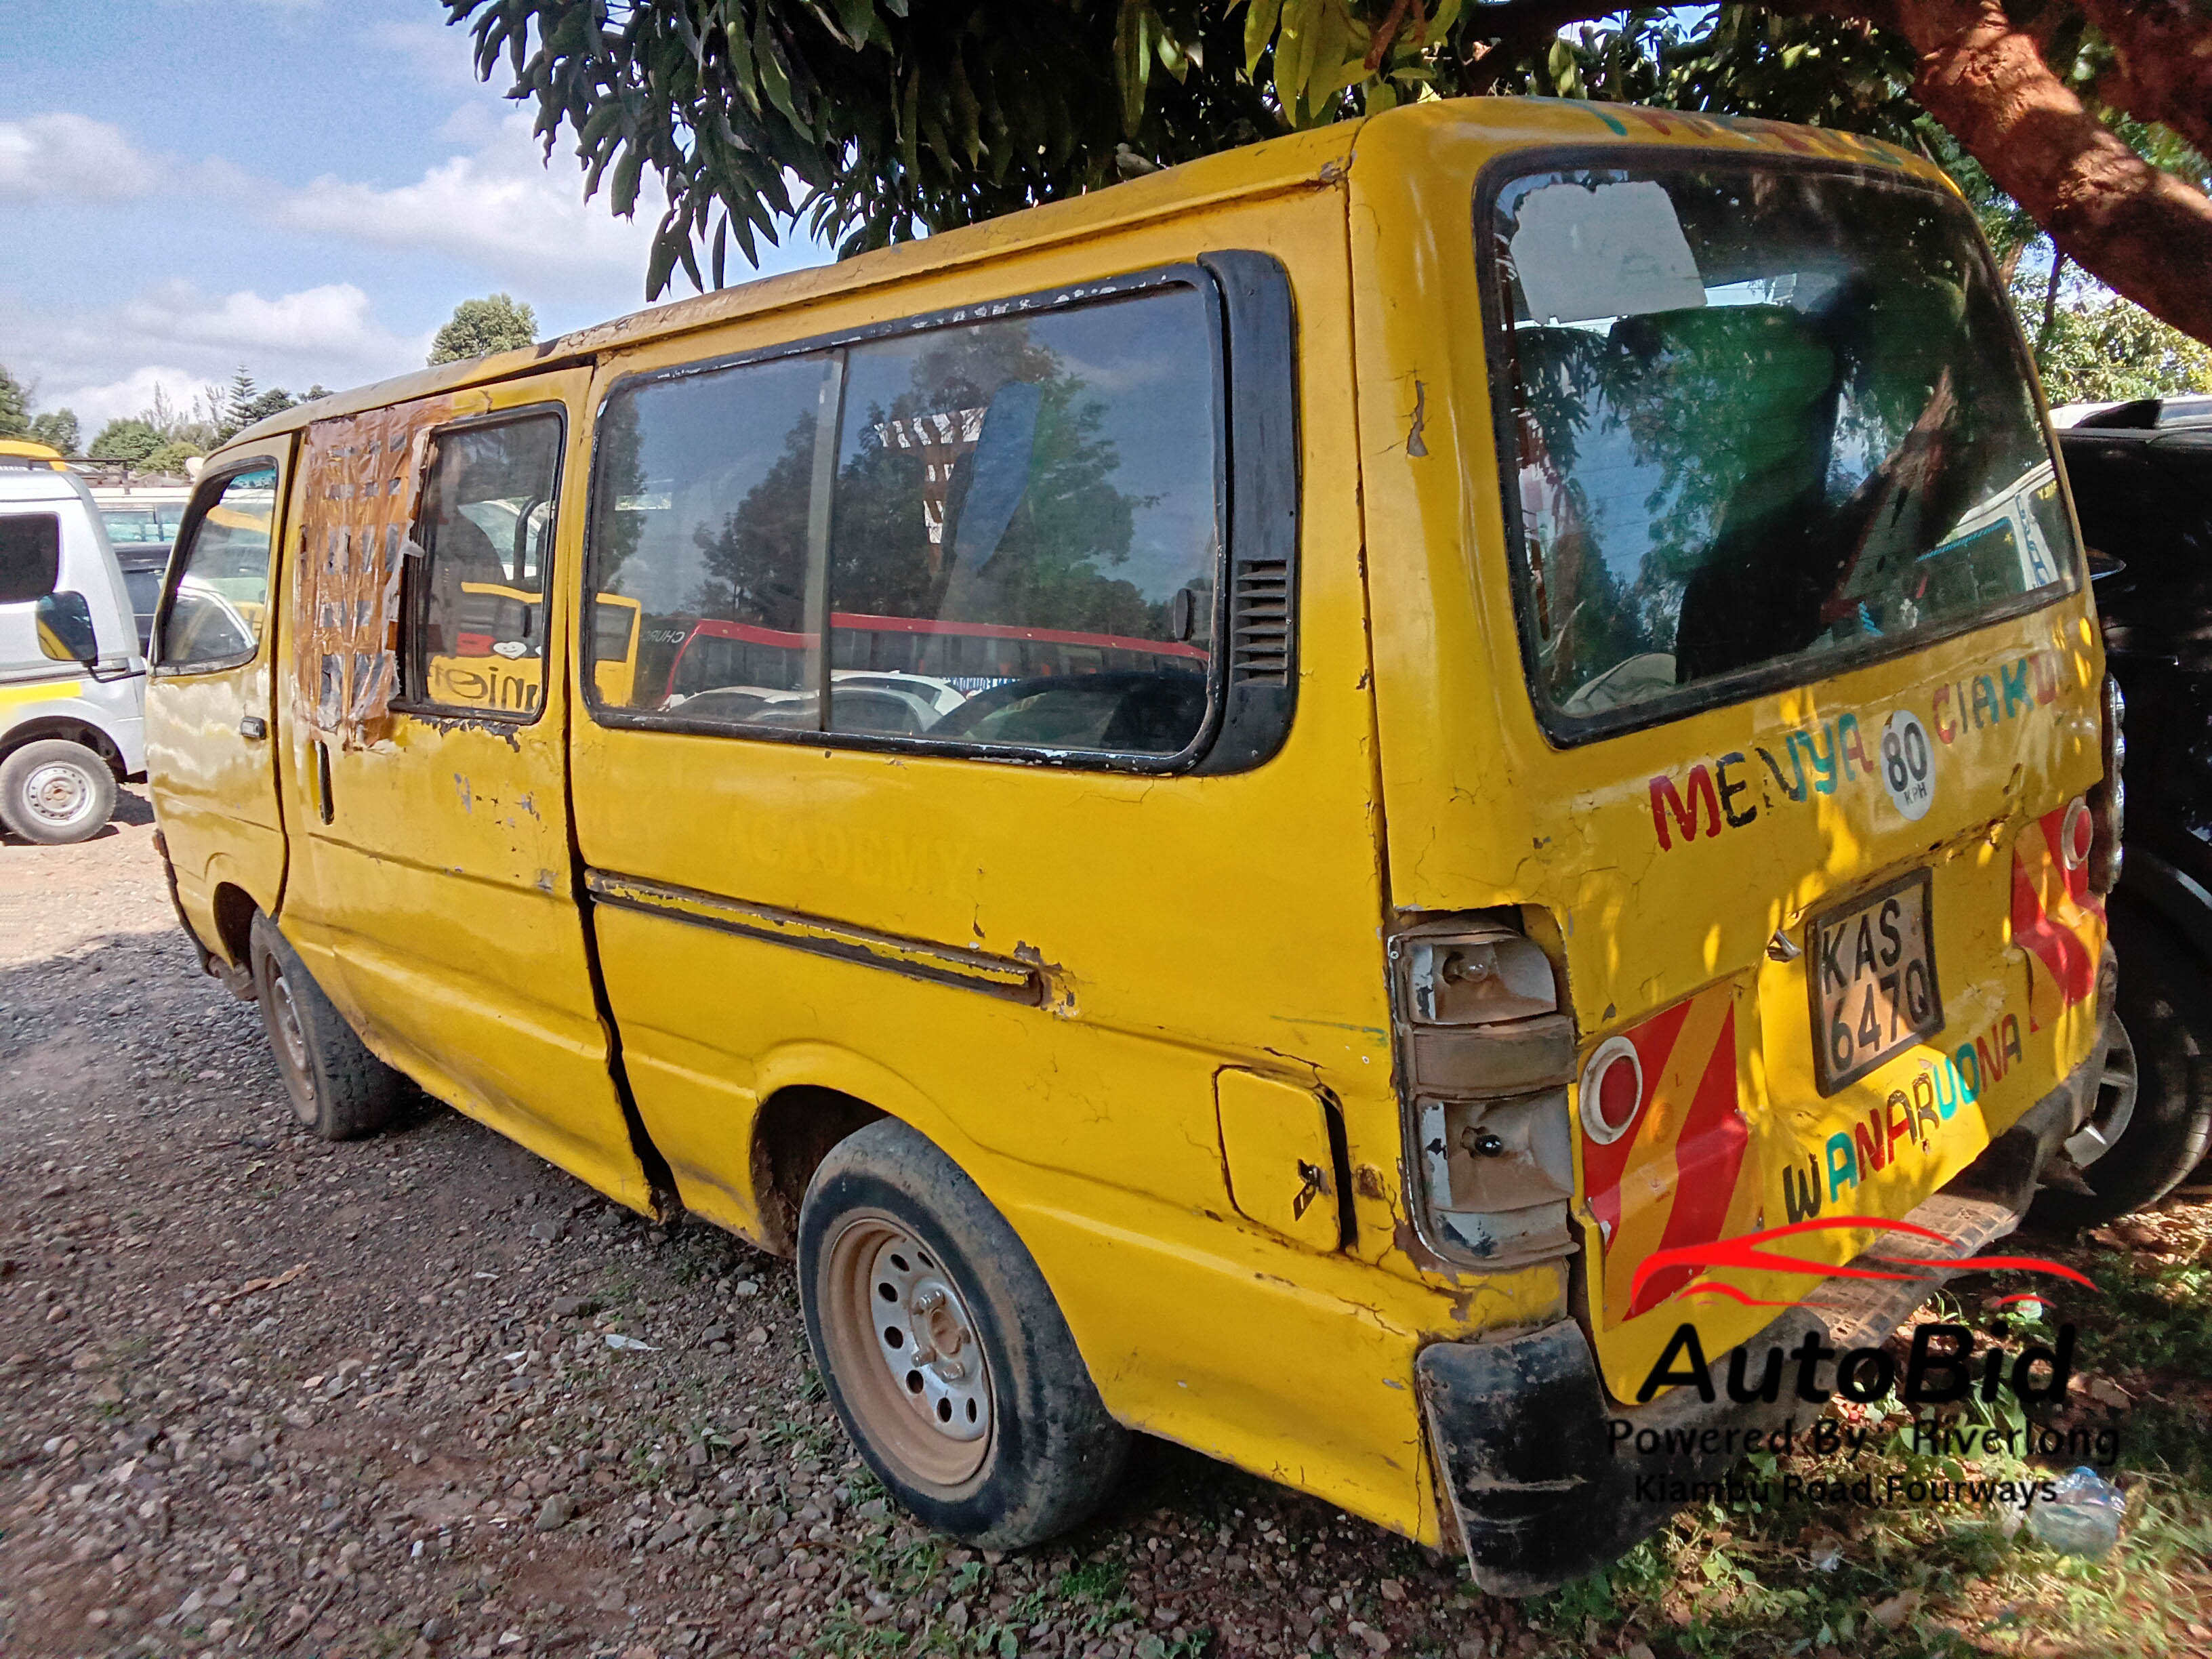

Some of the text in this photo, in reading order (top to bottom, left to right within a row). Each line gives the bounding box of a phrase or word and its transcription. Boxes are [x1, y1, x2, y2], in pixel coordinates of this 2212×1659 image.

[1650, 713, 1874, 852] MENYA
[1883, 722, 1927, 792] 80
[1904, 781, 1927, 806] KPH
[717, 808, 969, 899] ACADEMY
[1822, 899, 1901, 995] KAS
[1831, 958, 1929, 1070] 647Q
[1782, 1013, 2022, 1224] WANARUONA
